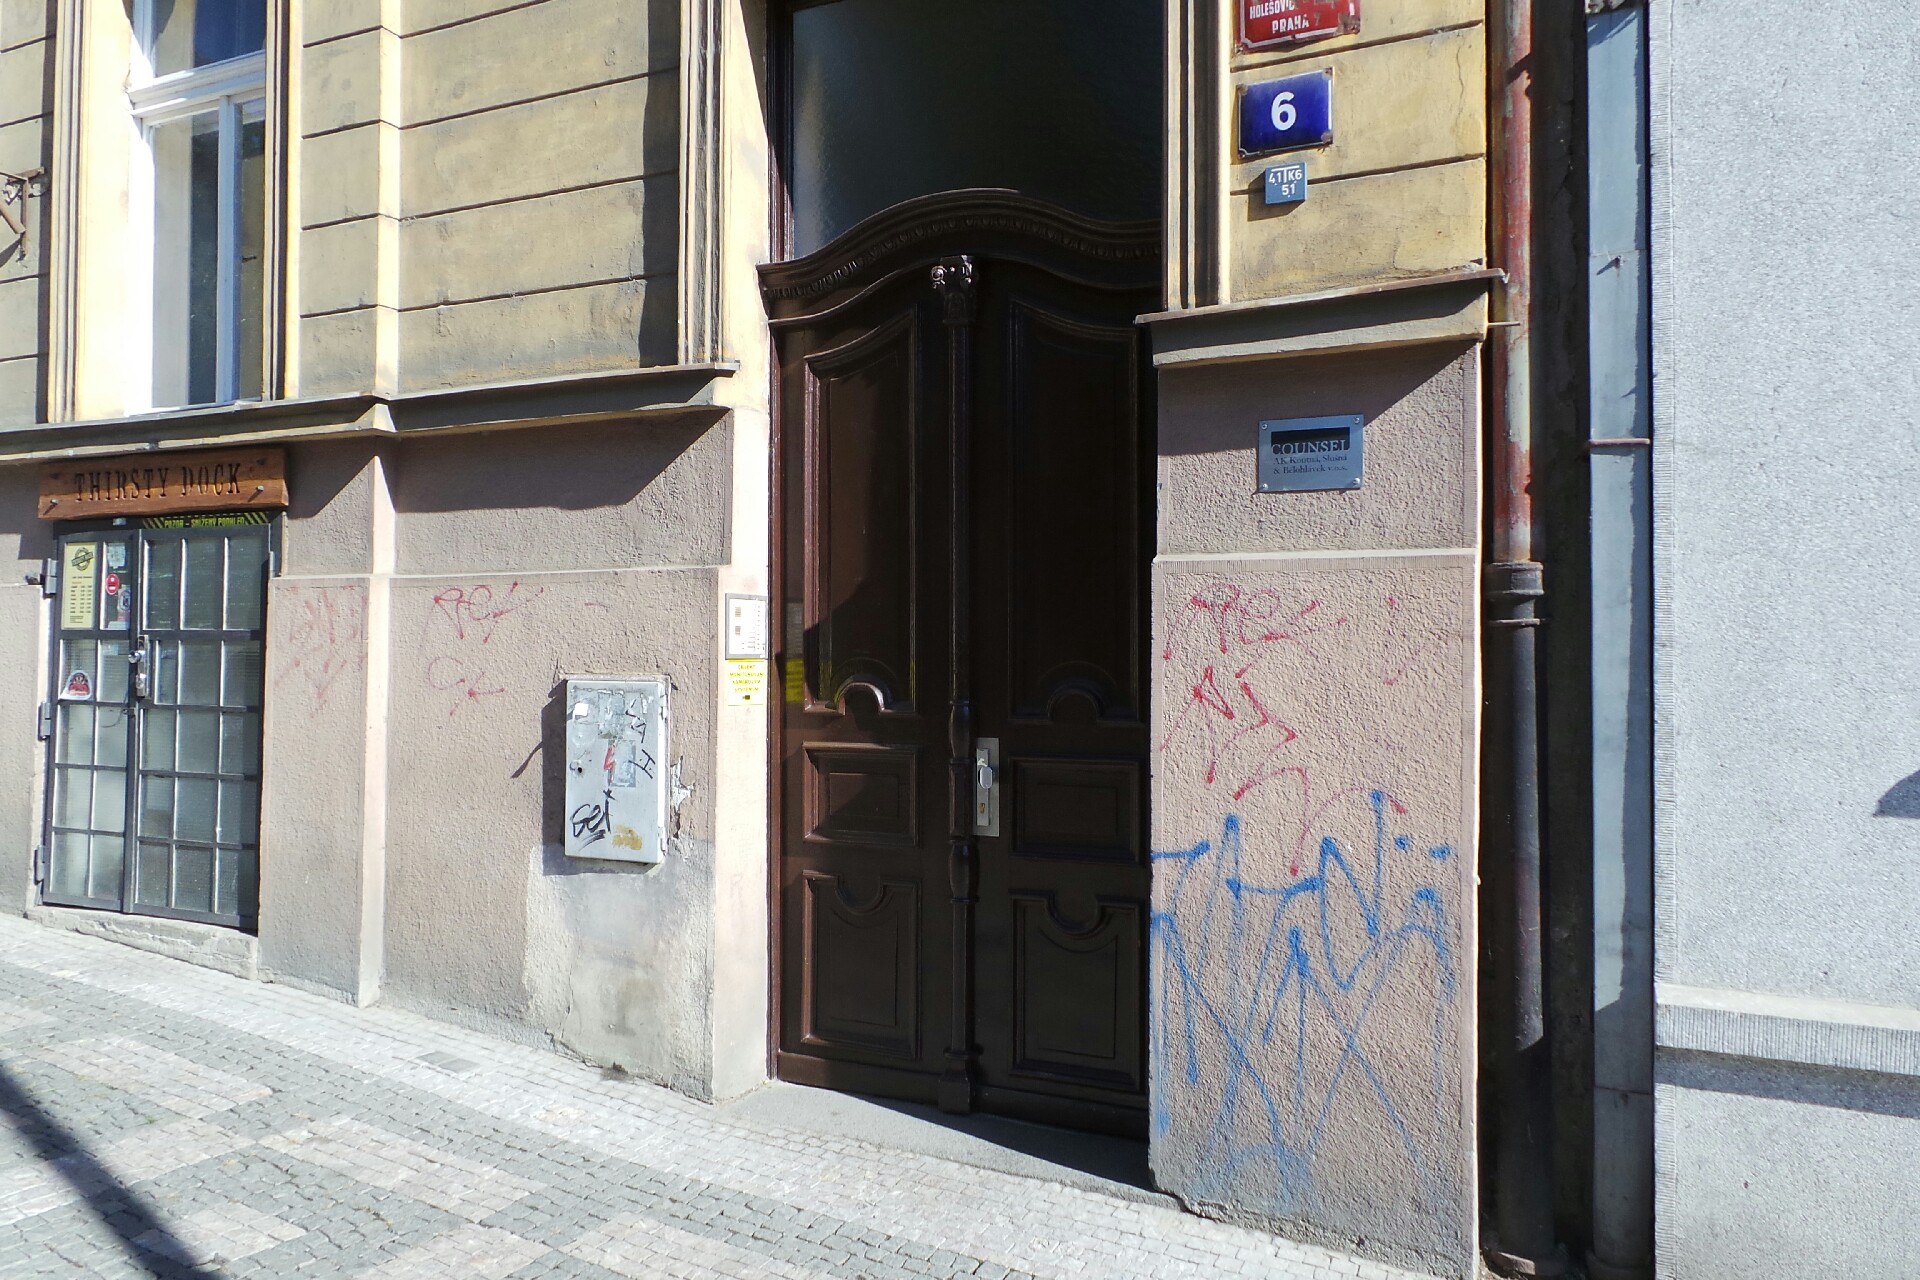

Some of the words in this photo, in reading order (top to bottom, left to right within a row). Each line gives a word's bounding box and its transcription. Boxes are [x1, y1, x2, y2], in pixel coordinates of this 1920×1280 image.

[1272, 14, 1309, 34] PRAHA
[1271, 91, 1297, 131] 6
[1271, 440, 1350, 456] COUNSEL
[74, 467, 170, 502] THIRSTY
[181, 463, 241, 497] DOCK
